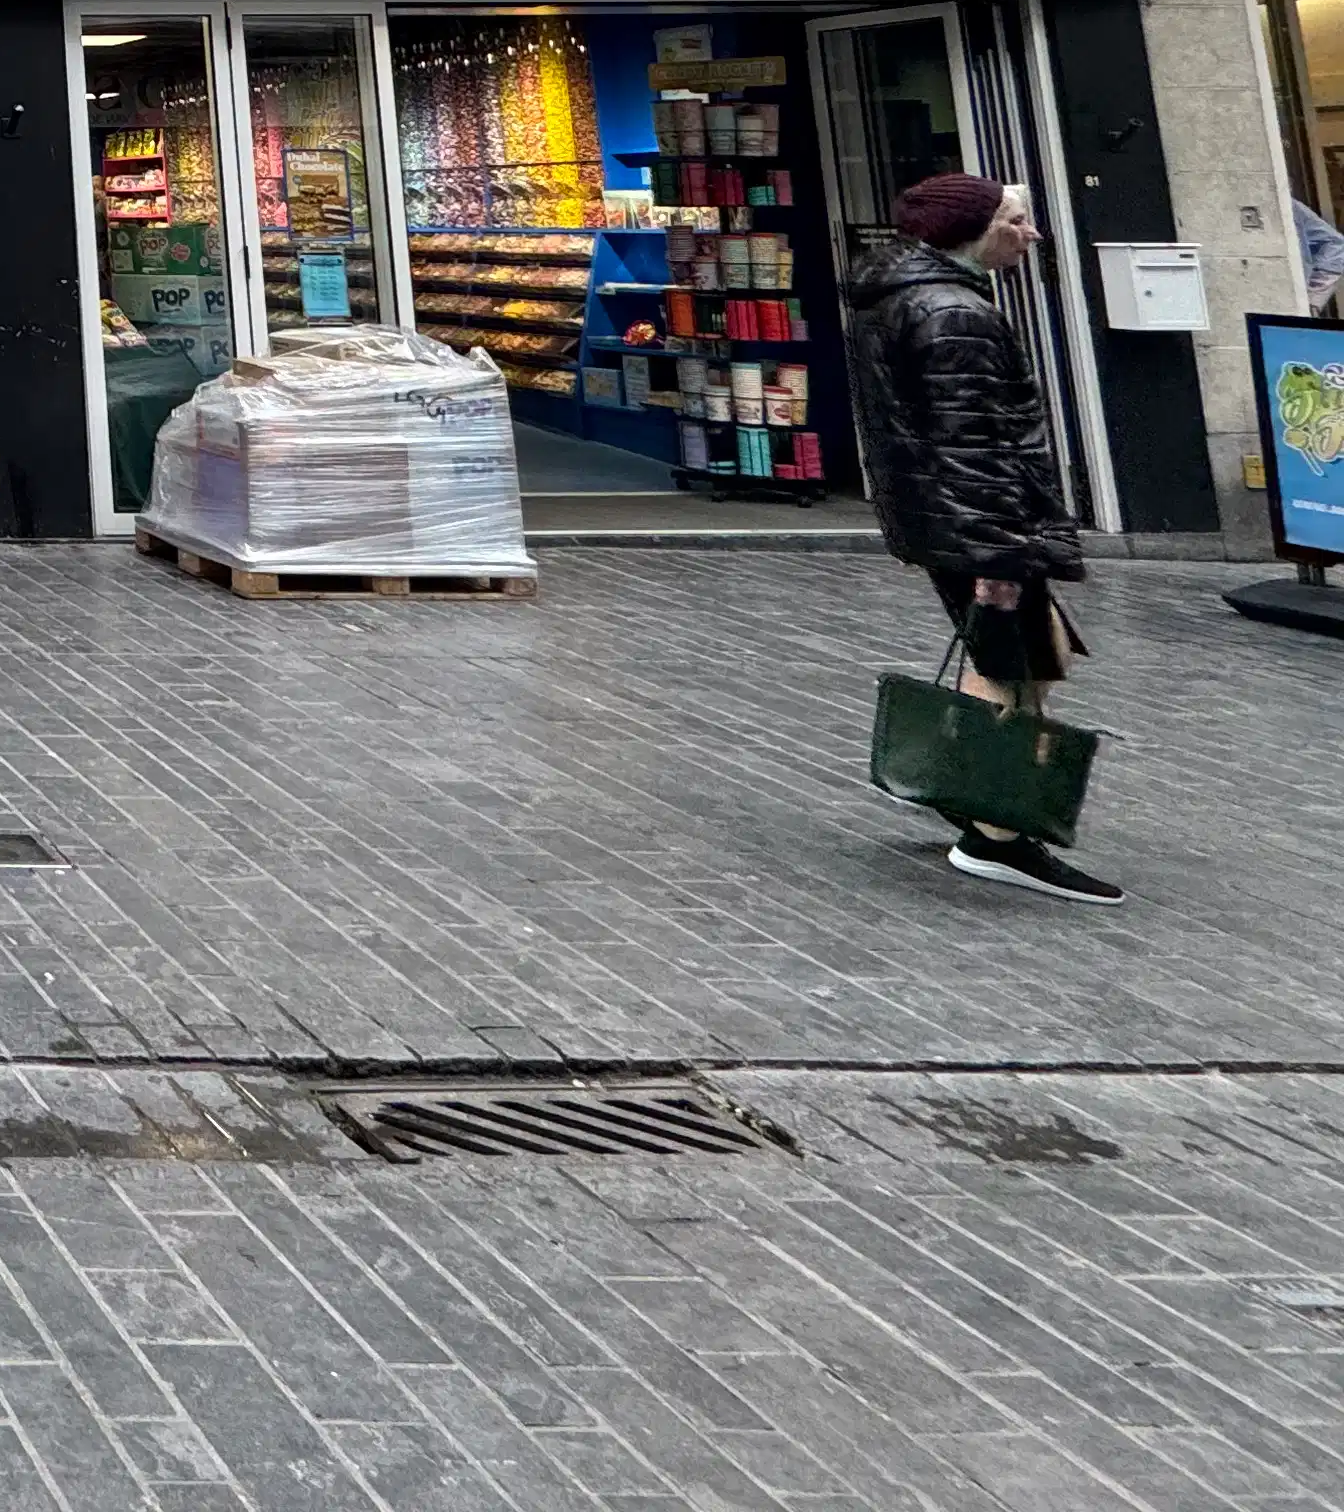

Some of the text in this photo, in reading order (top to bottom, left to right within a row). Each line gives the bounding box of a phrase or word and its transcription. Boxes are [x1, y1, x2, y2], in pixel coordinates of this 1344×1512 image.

[289, 162, 344, 172] Chocolate
[1085, 175, 1100, 186] 81
[151, 288, 191, 313] POP
